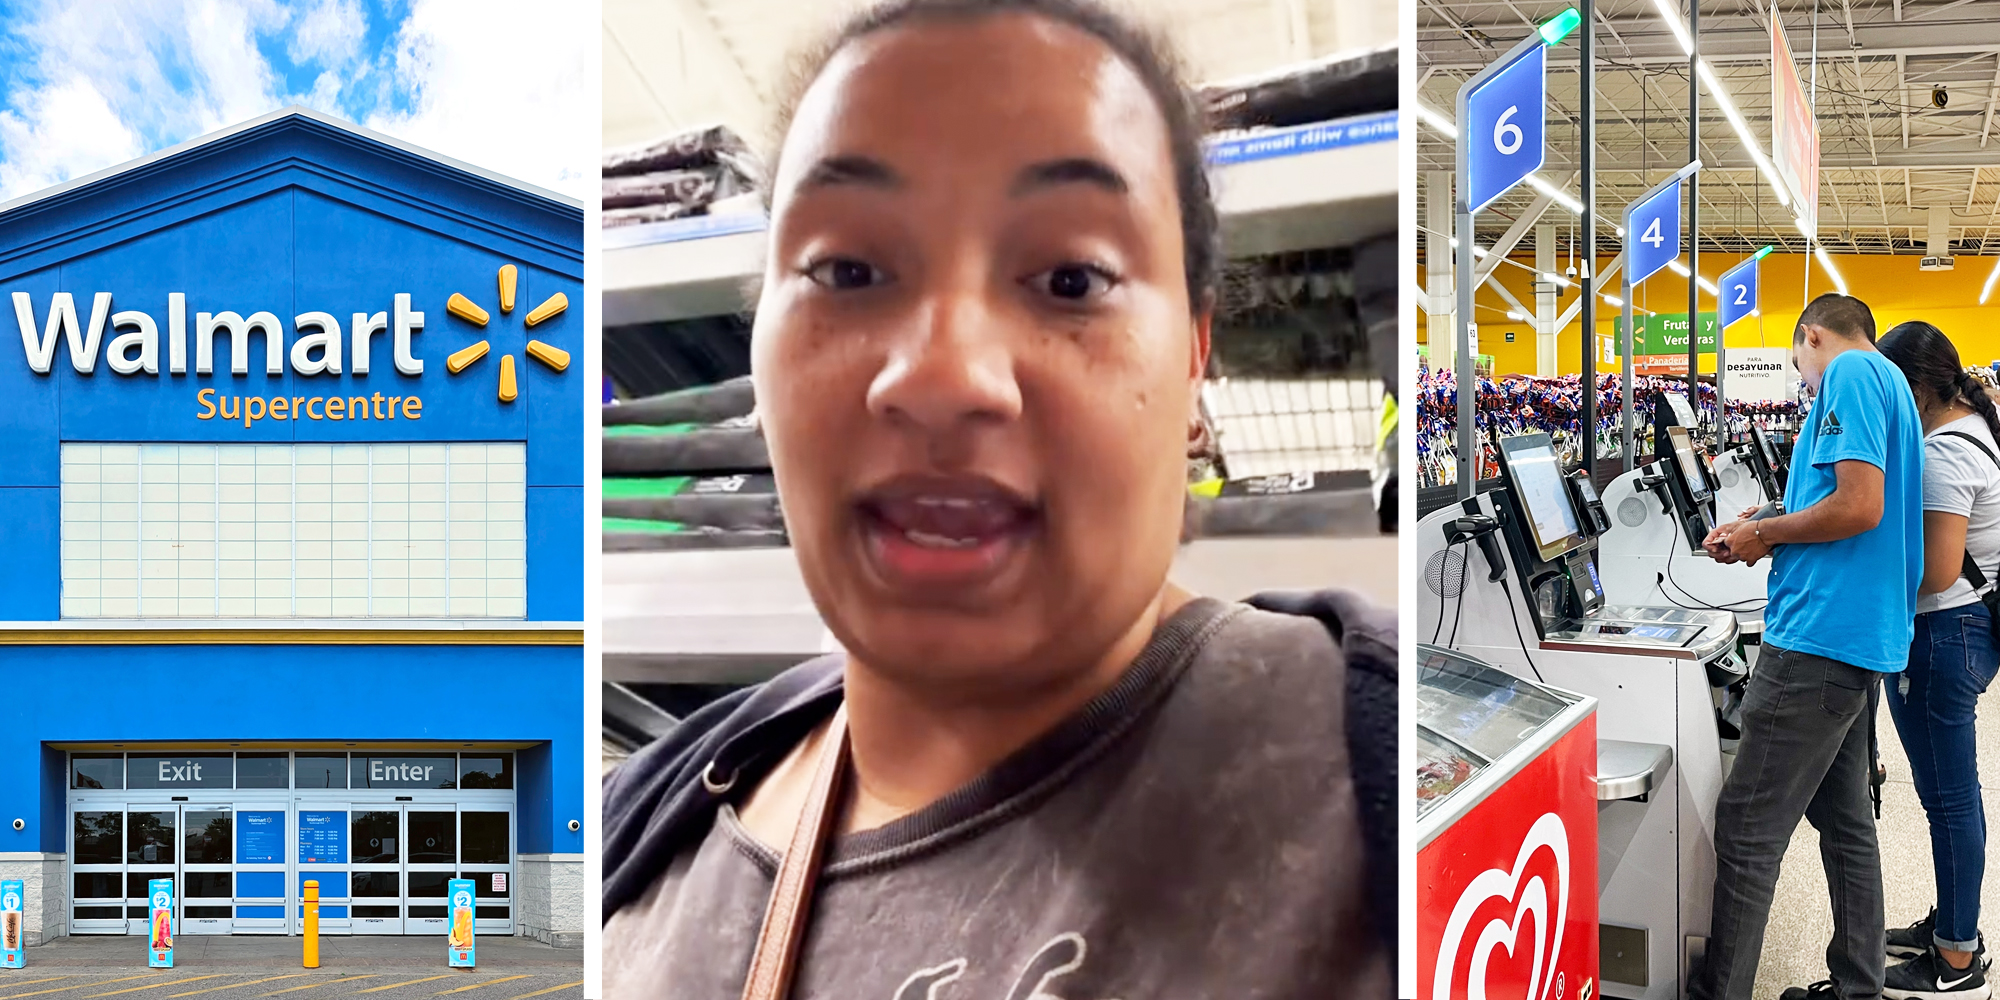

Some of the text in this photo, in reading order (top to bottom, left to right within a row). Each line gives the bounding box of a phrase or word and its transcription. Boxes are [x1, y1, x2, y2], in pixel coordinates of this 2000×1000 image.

[1493, 105, 1523, 155] 6
[1640, 217, 1664, 248] 4
[1733, 284, 1747, 305] 2
[11, 291, 425, 376] Walmart
[1663, 320, 1714, 331] Frut y
[1663, 335, 1714, 345] Verdras
[197, 388, 423, 428] Supercentre
[159, 761, 202, 782] Exit
[371, 760, 434, 782] Enter
[156, 897, 166, 907] $2
[457, 896, 468, 907] $2
